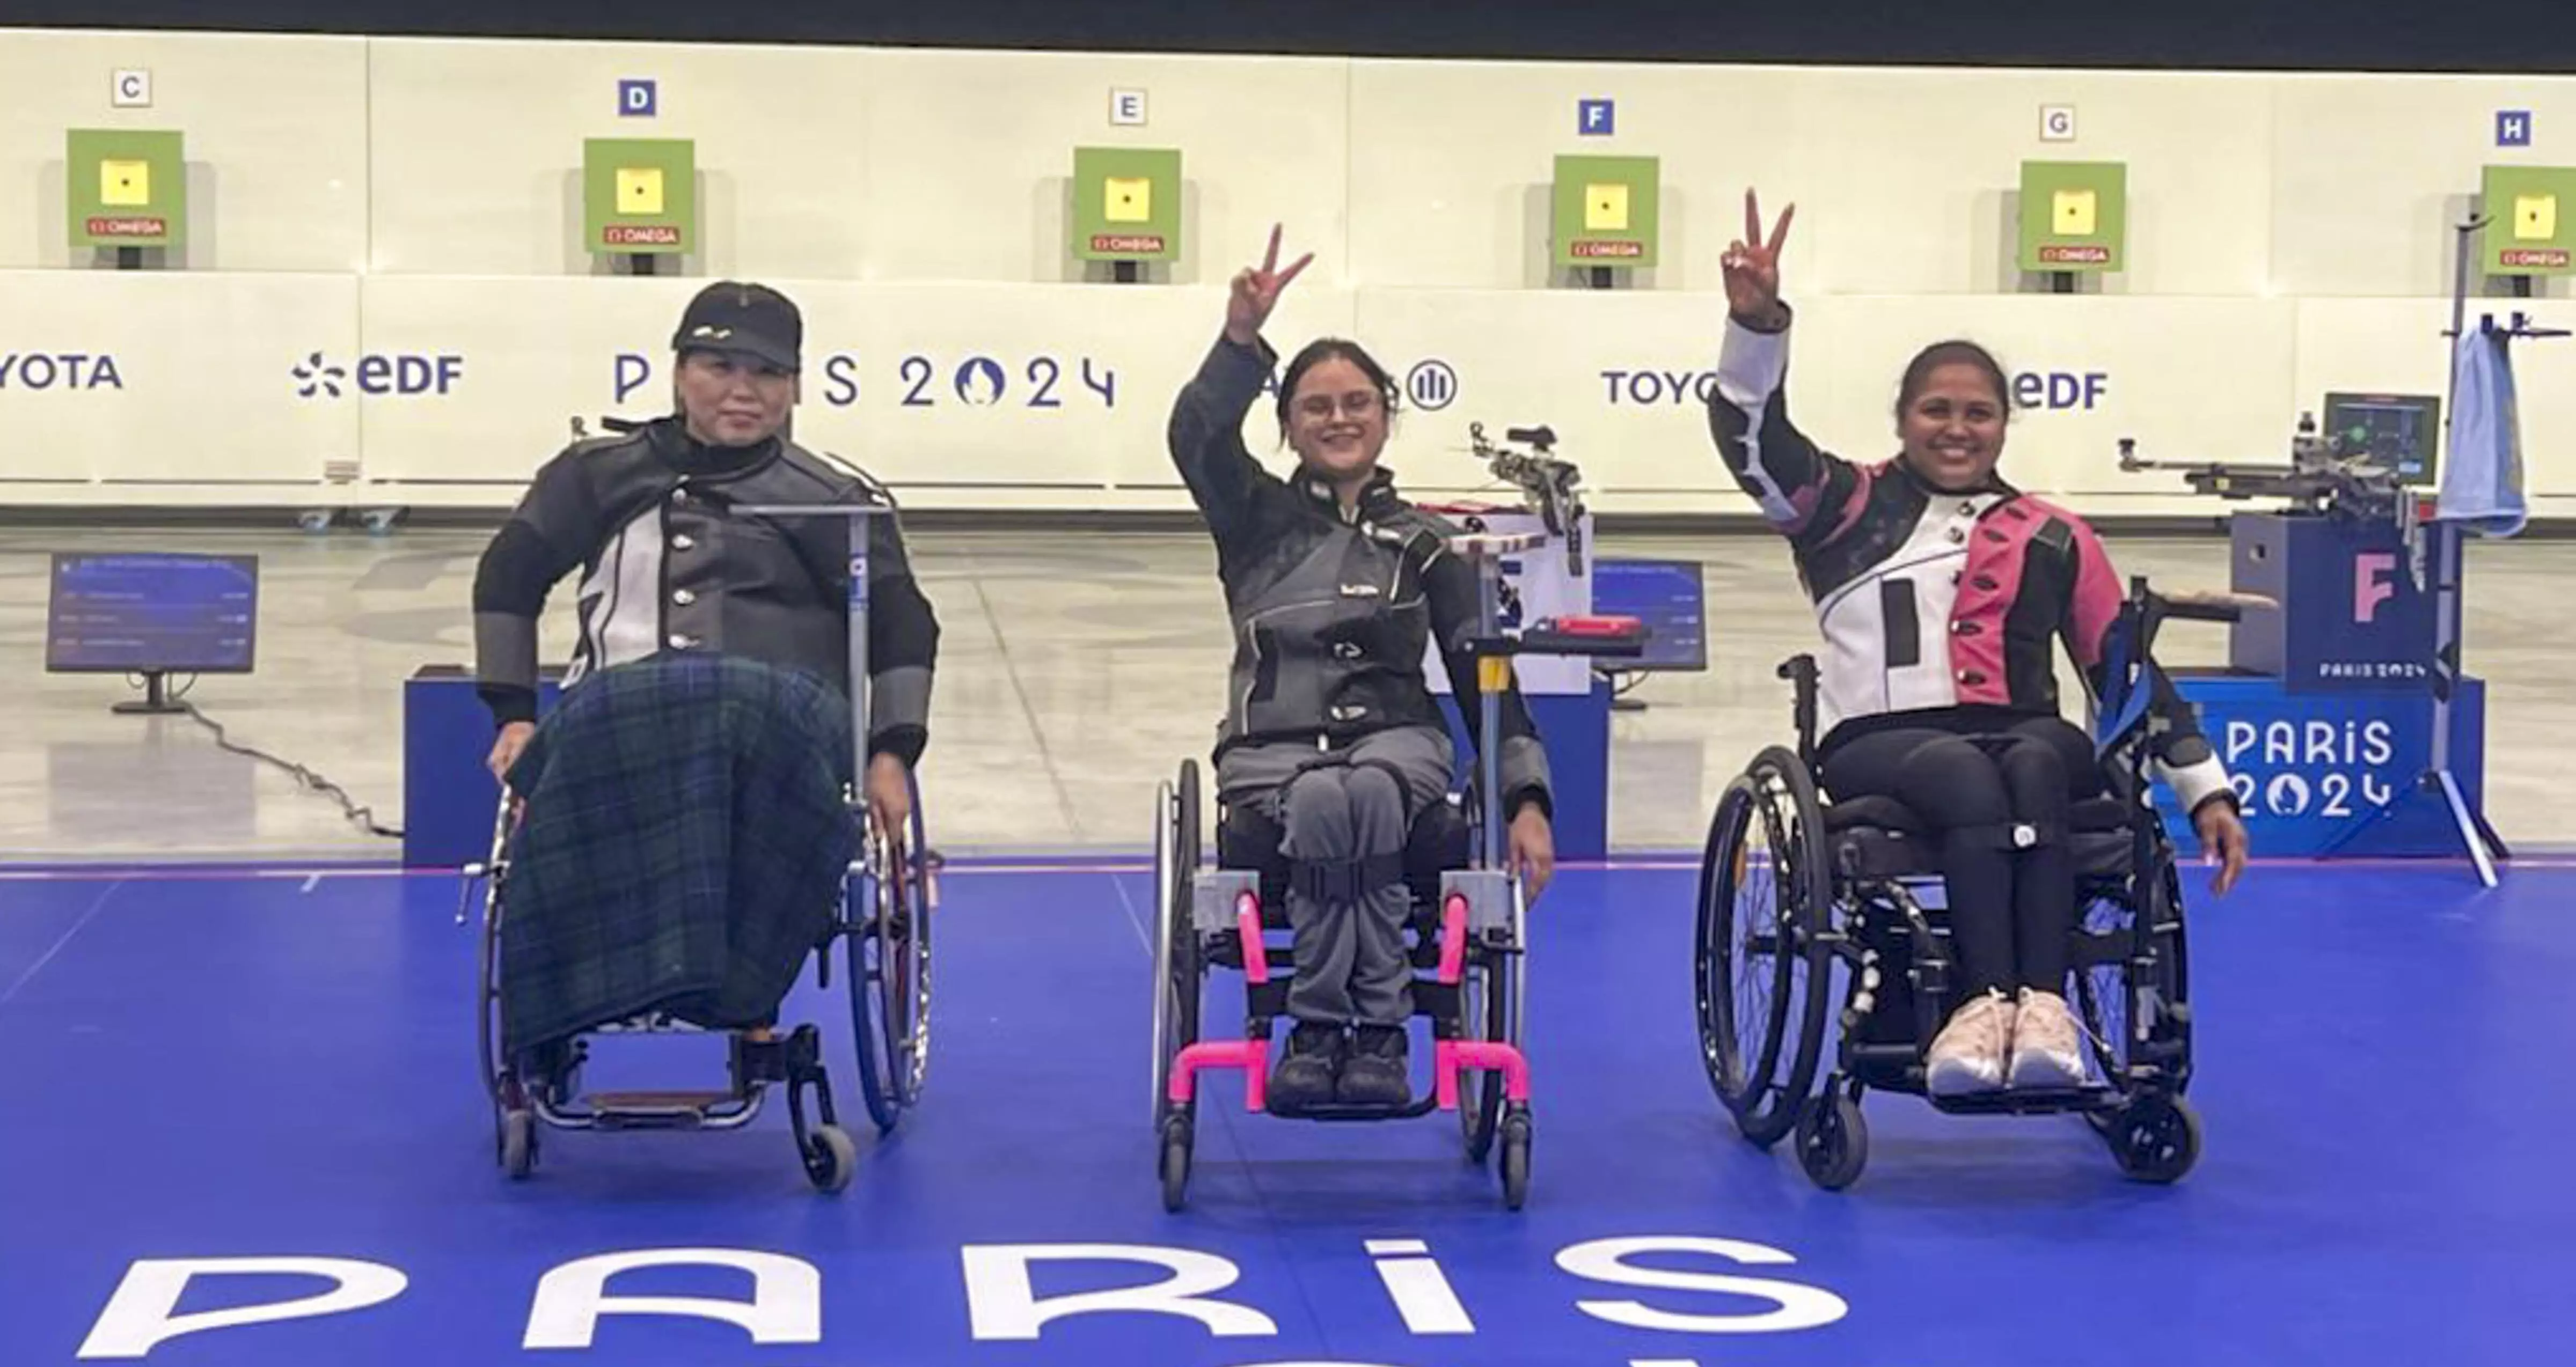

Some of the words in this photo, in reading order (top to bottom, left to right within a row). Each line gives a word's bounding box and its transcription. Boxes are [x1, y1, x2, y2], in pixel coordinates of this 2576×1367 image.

[121, 76, 140, 98] C
[628, 87, 648, 108] D
[1121, 97, 1137, 117] E
[1589, 106, 1604, 127] F
[2049, 112, 2068, 134] G
[2504, 119, 2522, 138] H
[107, 221, 162, 233] OMEGA
[624, 229, 676, 243] OMEGA
[1110, 238, 1161, 251] OMEGA
[1590, 245, 1638, 256] OMEGA
[2059, 249, 2106, 261] OMEGA
[0, 354, 122, 389] YOTA
[901, 356, 1114, 407] 2024
[1600, 371, 1718, 405] TOYO
[2354, 554, 2396, 622] F
[2230, 773, 2391, 816] 2024
